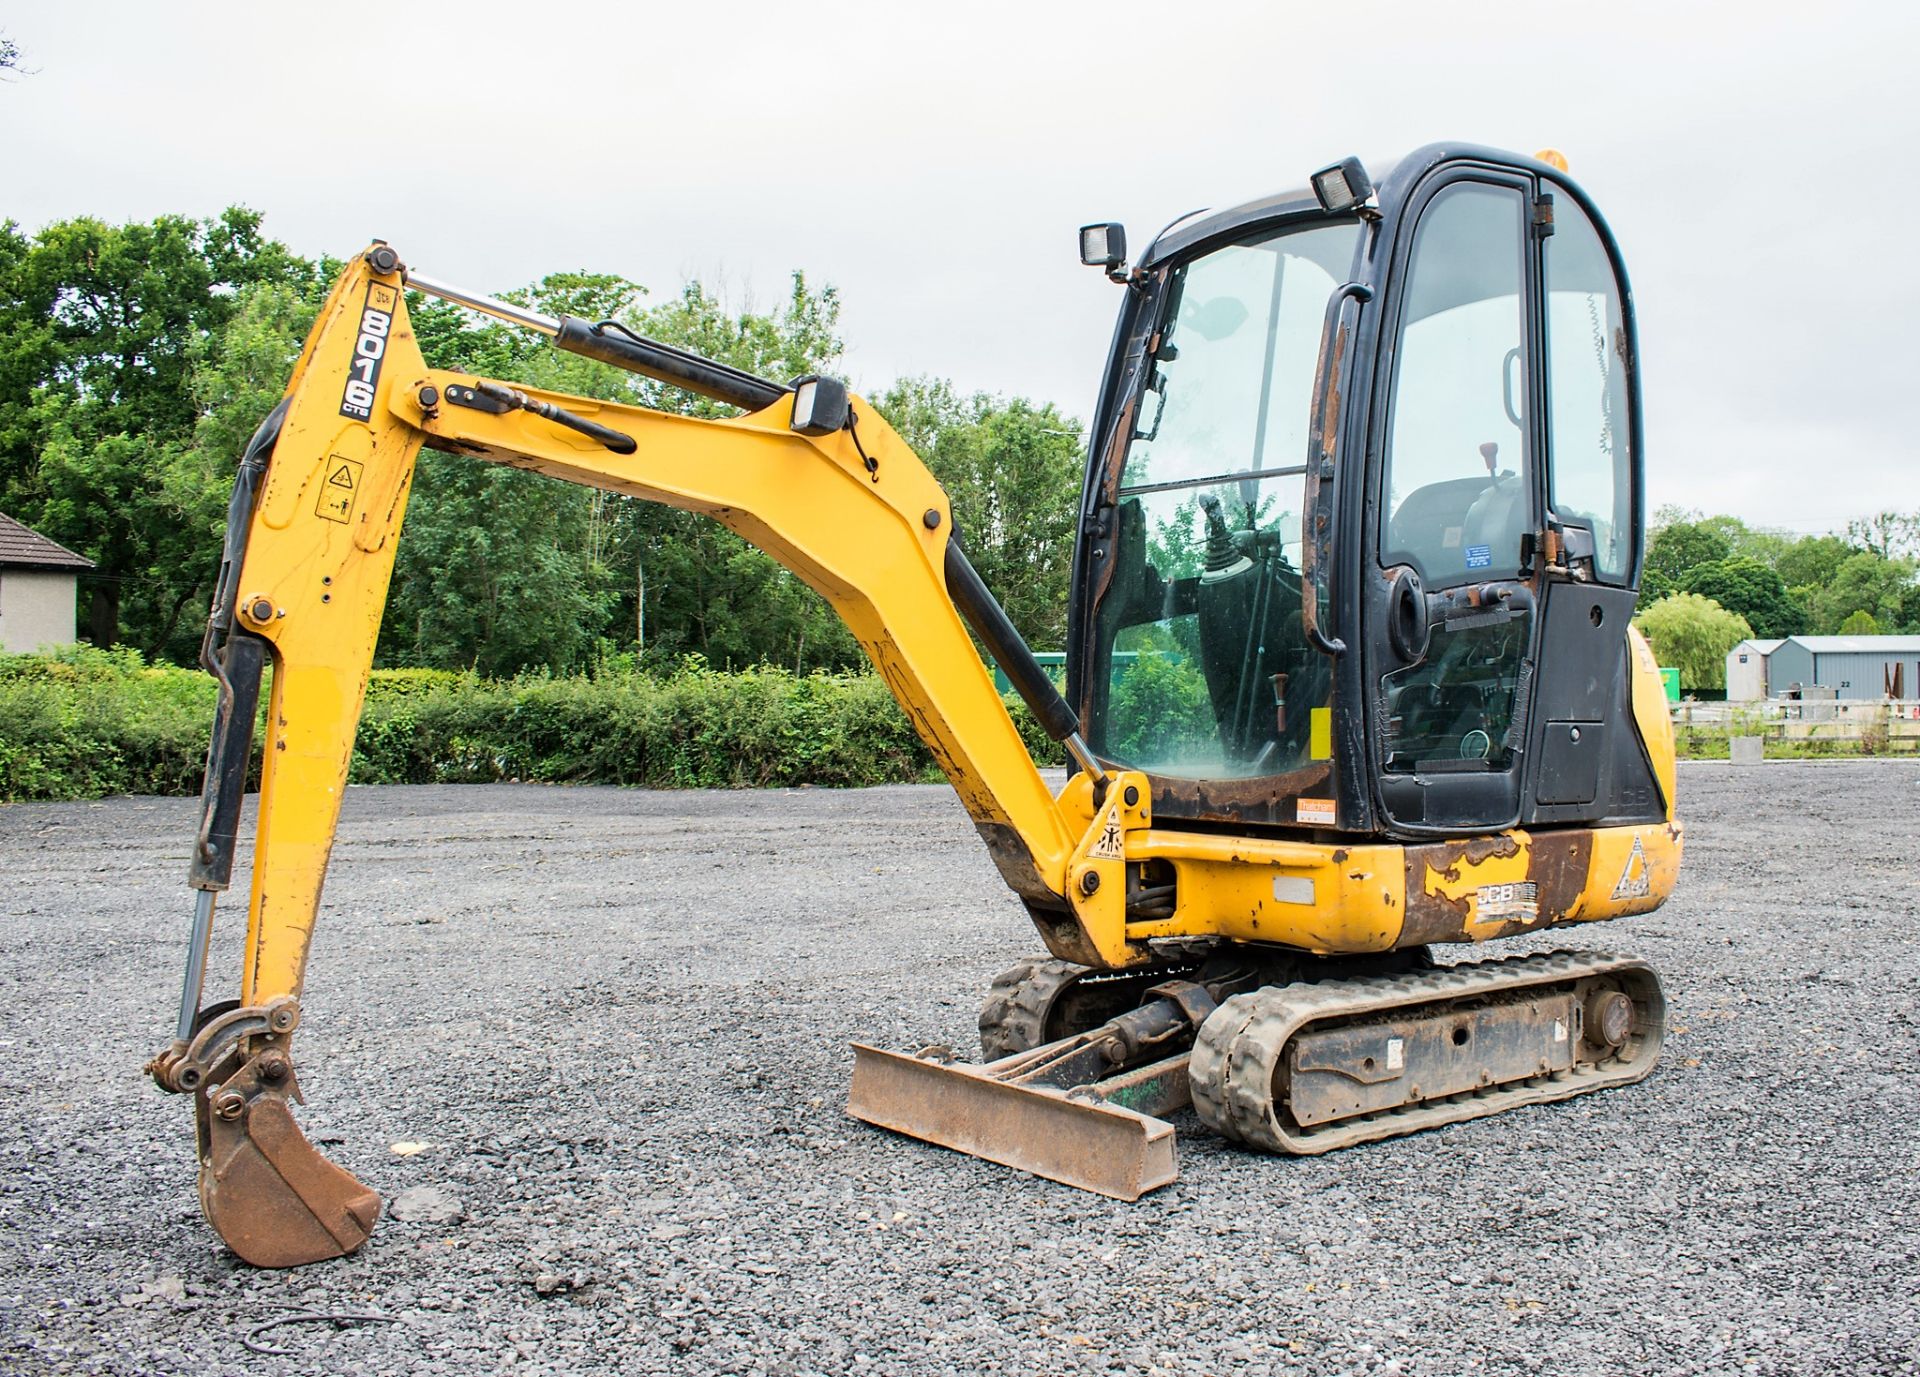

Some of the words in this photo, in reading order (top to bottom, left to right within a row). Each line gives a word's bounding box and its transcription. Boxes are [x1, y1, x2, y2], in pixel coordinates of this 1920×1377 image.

[345, 309, 391, 408] 8016
[342, 403, 369, 416] CTS
[1840, 680, 1851, 688] 22
